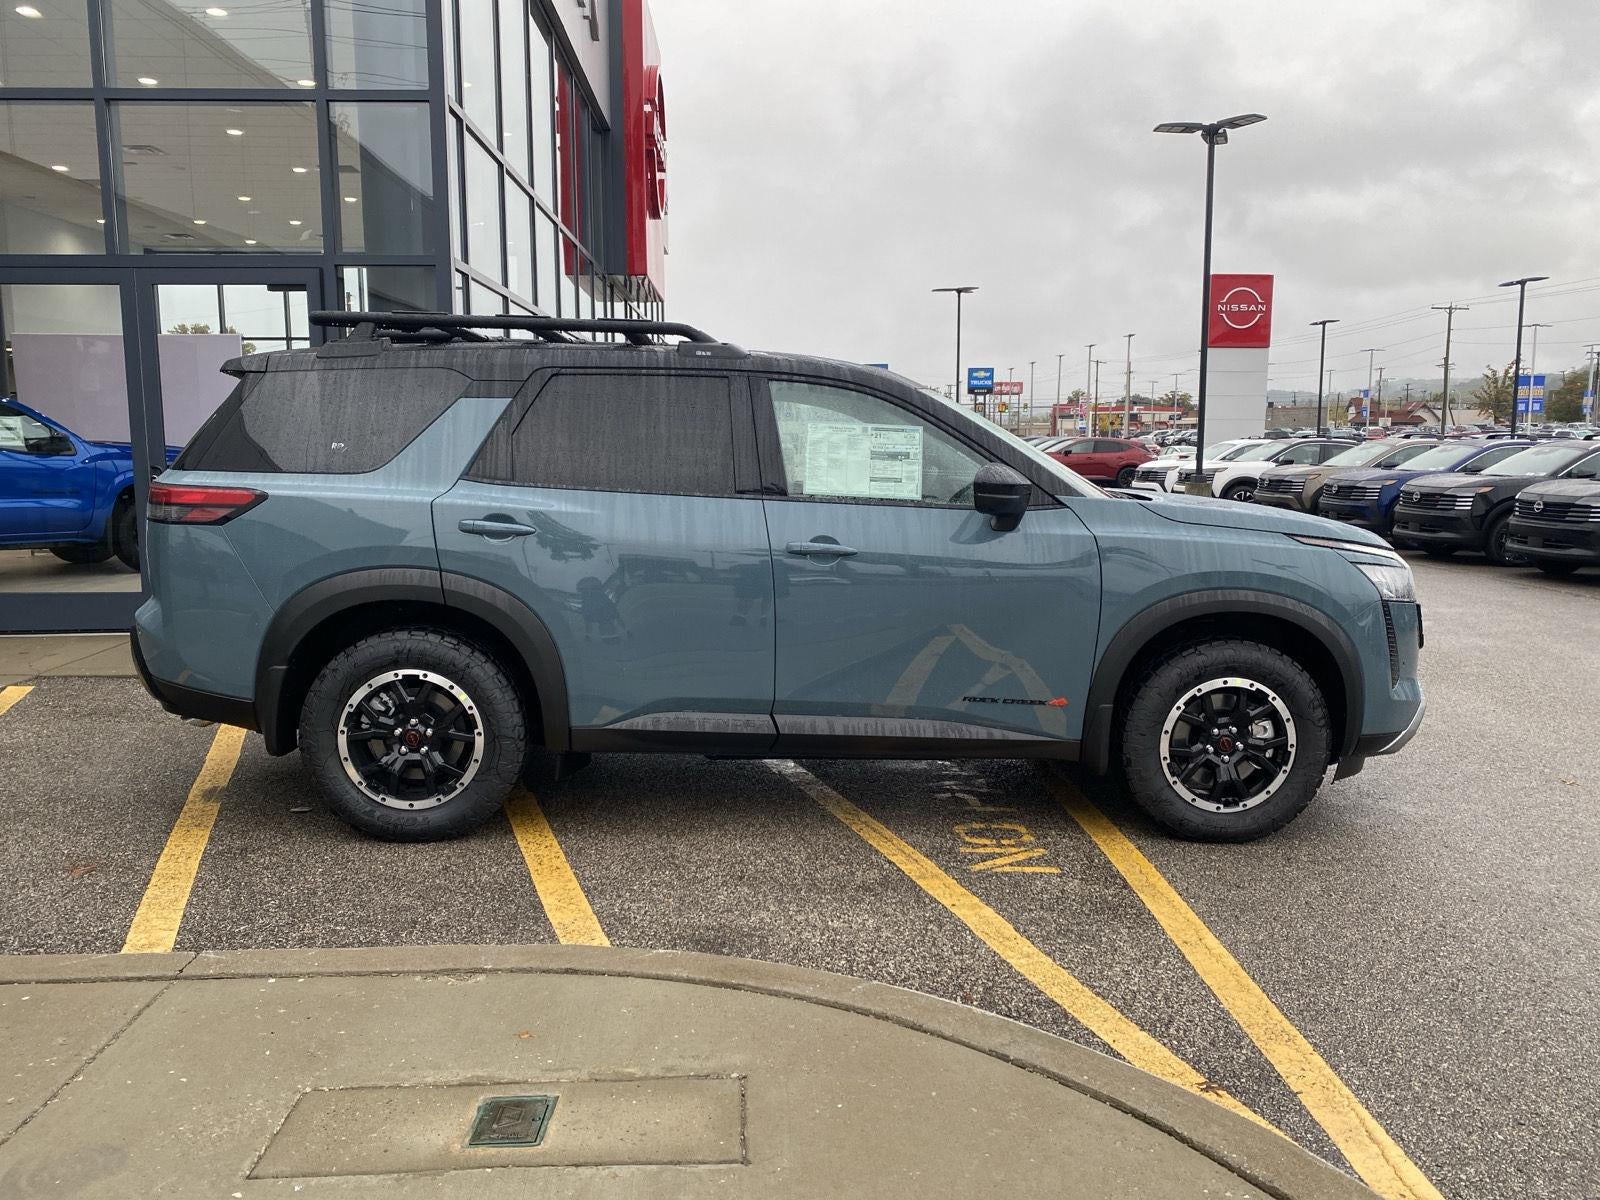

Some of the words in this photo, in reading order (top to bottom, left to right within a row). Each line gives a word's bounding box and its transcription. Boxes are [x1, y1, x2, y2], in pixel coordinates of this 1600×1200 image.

[1217, 304, 1266, 312] NISSAN
[962, 695, 1000, 704] ROCK
[1002, 697, 1048, 705] CREEK
